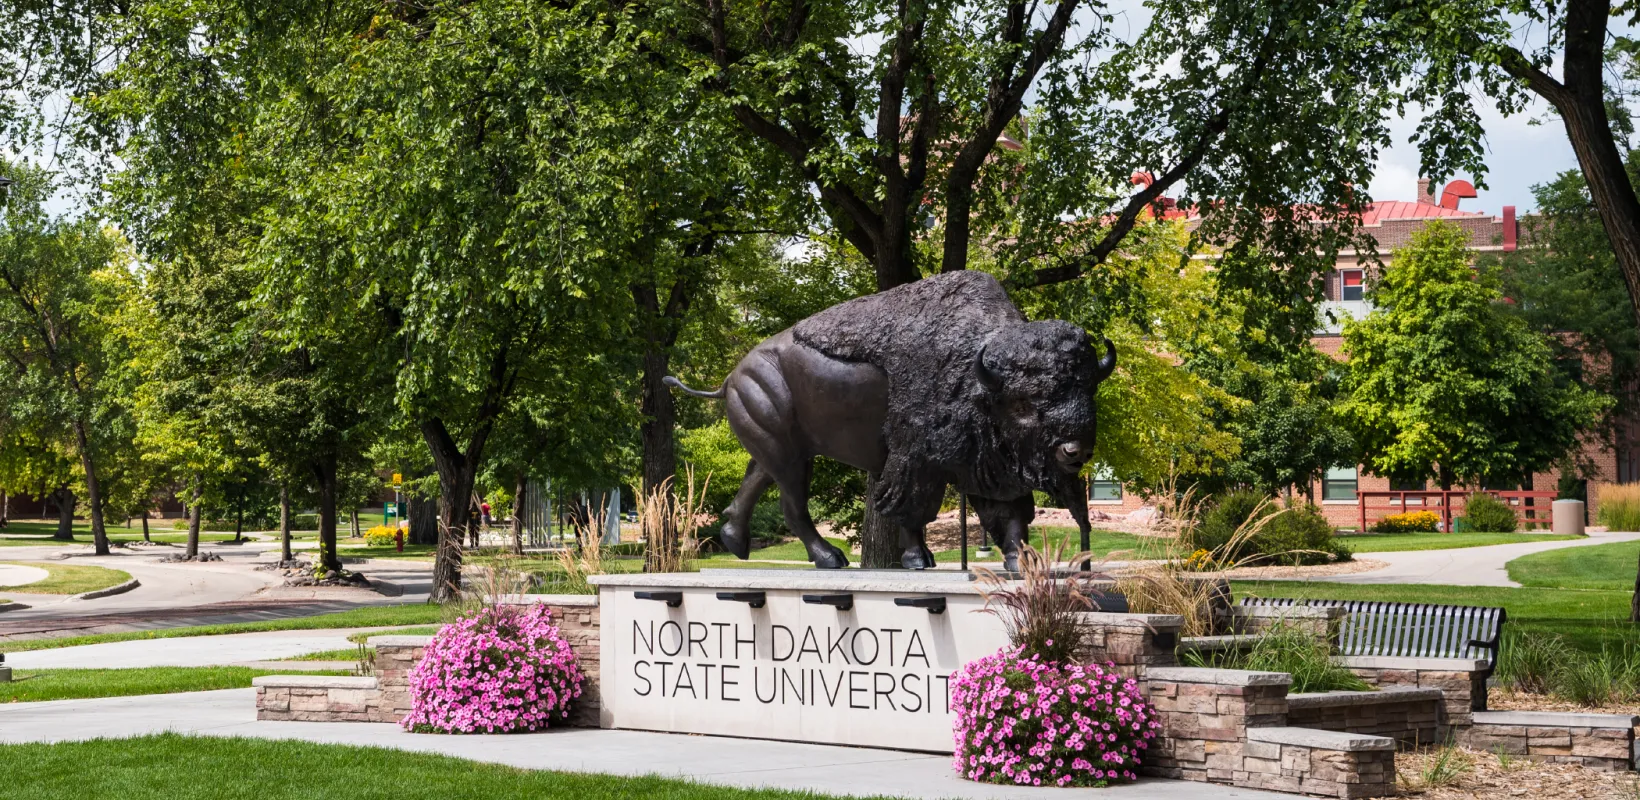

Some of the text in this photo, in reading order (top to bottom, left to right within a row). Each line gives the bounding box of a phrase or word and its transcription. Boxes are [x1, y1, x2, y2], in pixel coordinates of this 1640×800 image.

[633, 619, 930, 668] NORTH DAKOTA
[633, 660, 950, 714] STATE UNIVERSIT
